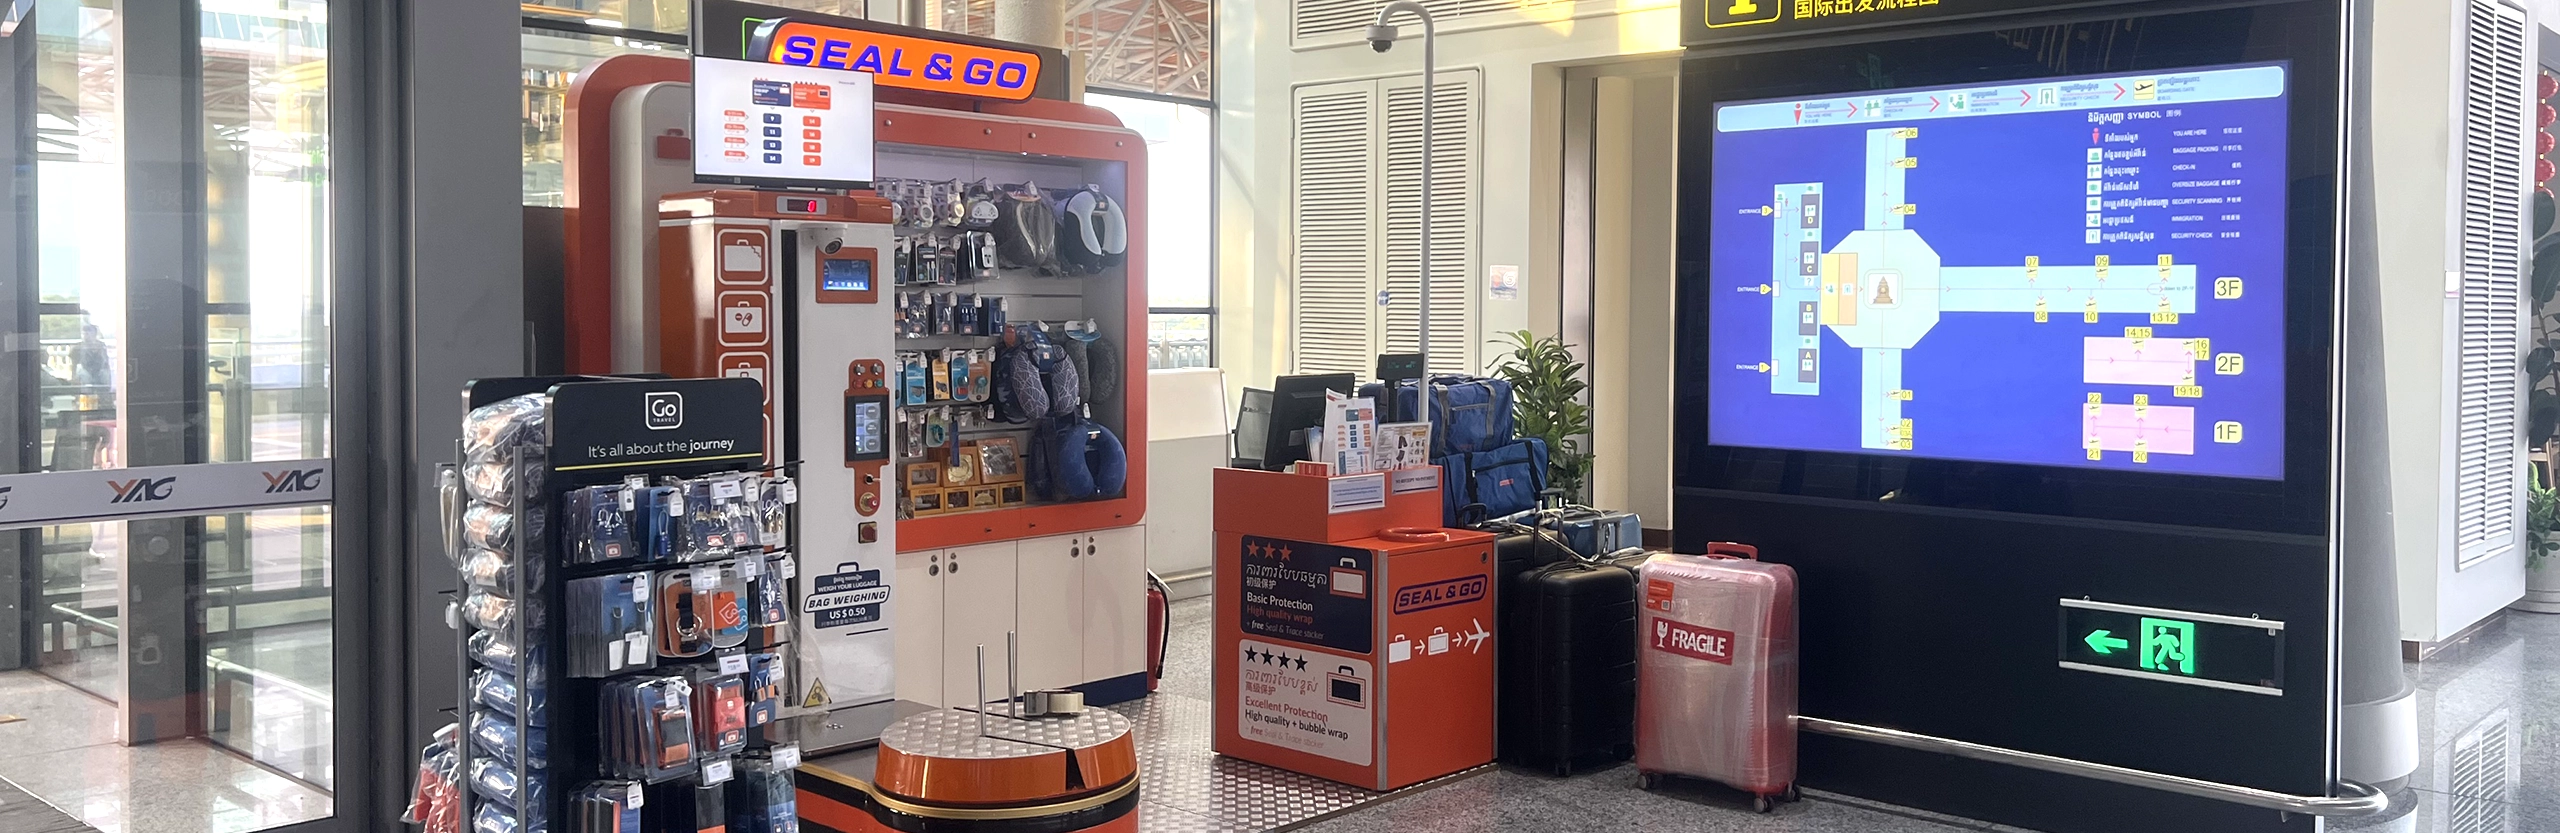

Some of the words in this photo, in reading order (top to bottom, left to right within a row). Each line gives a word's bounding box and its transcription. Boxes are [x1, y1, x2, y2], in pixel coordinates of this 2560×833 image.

[782, 35, 912, 77] SEAL
[923, 53, 953, 82] &
[963, 58, 1027, 89] GO
[2127, 111, 2162, 120] SYMBOL
[1906, 129, 1917, 137] 06
[1905, 158, 1916, 167] 05
[1904, 205, 1915, 214] 04
[2026, 258, 2037, 266] 07
[2096, 257, 2107, 265] 09
[2159, 256, 2170, 265] 11
[2216, 280, 2239, 296] 3F
[2035, 311, 2047, 321] 08
[2085, 312, 2097, 321] 10
[2196, 340, 2207, 349] 16
[2196, 351, 2207, 359] 17
[2217, 356, 2241, 372] 2F
[1901, 391, 1912, 399] 01
[2089, 394, 2100, 402] 22
[2135, 396, 2147, 404] 23
[651, 399, 677, 417] Go
[1900, 419, 1911, 427] 02
[2216, 424, 2238, 440] 1F
[588, 445, 607, 458] It's
[609, 443, 623, 457] all
[626, 442, 665, 456] about
[666, 441, 687, 452] the
[688, 438, 735, 454] journey
[1900, 440, 1911, 448] 03
[2088, 451, 2099, 459] 21
[2135, 452, 2147, 461] 20
[853, 580, 877, 588] LUGGAGE
[1246, 577, 1277, 590] 初级保护
[1399, 588, 1442, 607] SEAL
[1446, 585, 1456, 599] &
[1460, 581, 1482, 596] GO
[809, 598, 830, 608] BAG
[834, 591, 886, 605] WEIGHING
[1247, 592, 1268, 604] Basic
[1270, 595, 1313, 611] Protection
[829, 610, 840, 619] US
[1247, 605, 1264, 616] High
[1266, 608, 1291, 622] quality
[1293, 615, 1313, 625] wrap
[1251, 620, 1264, 630] free
[1265, 622, 1278, 632] Seal
[1279, 624, 1284, 633] &
[1286, 625, 1302, 636] Trace
[1304, 628, 1324, 640] sticker
[1671, 628, 1726, 657] FRAGILE
[1245, 681, 1276, 695] 高级保护
[1245, 696, 1281, 712] Excellent
[1284, 704, 1328, 722] Protection
[1245, 709, 1262, 721] High
[1264, 714, 1290, 728] quality
[1299, 721, 1326, 735] bubble
[1328, 728, 1348, 740] wrap
[1250, 726, 1263, 736] free
